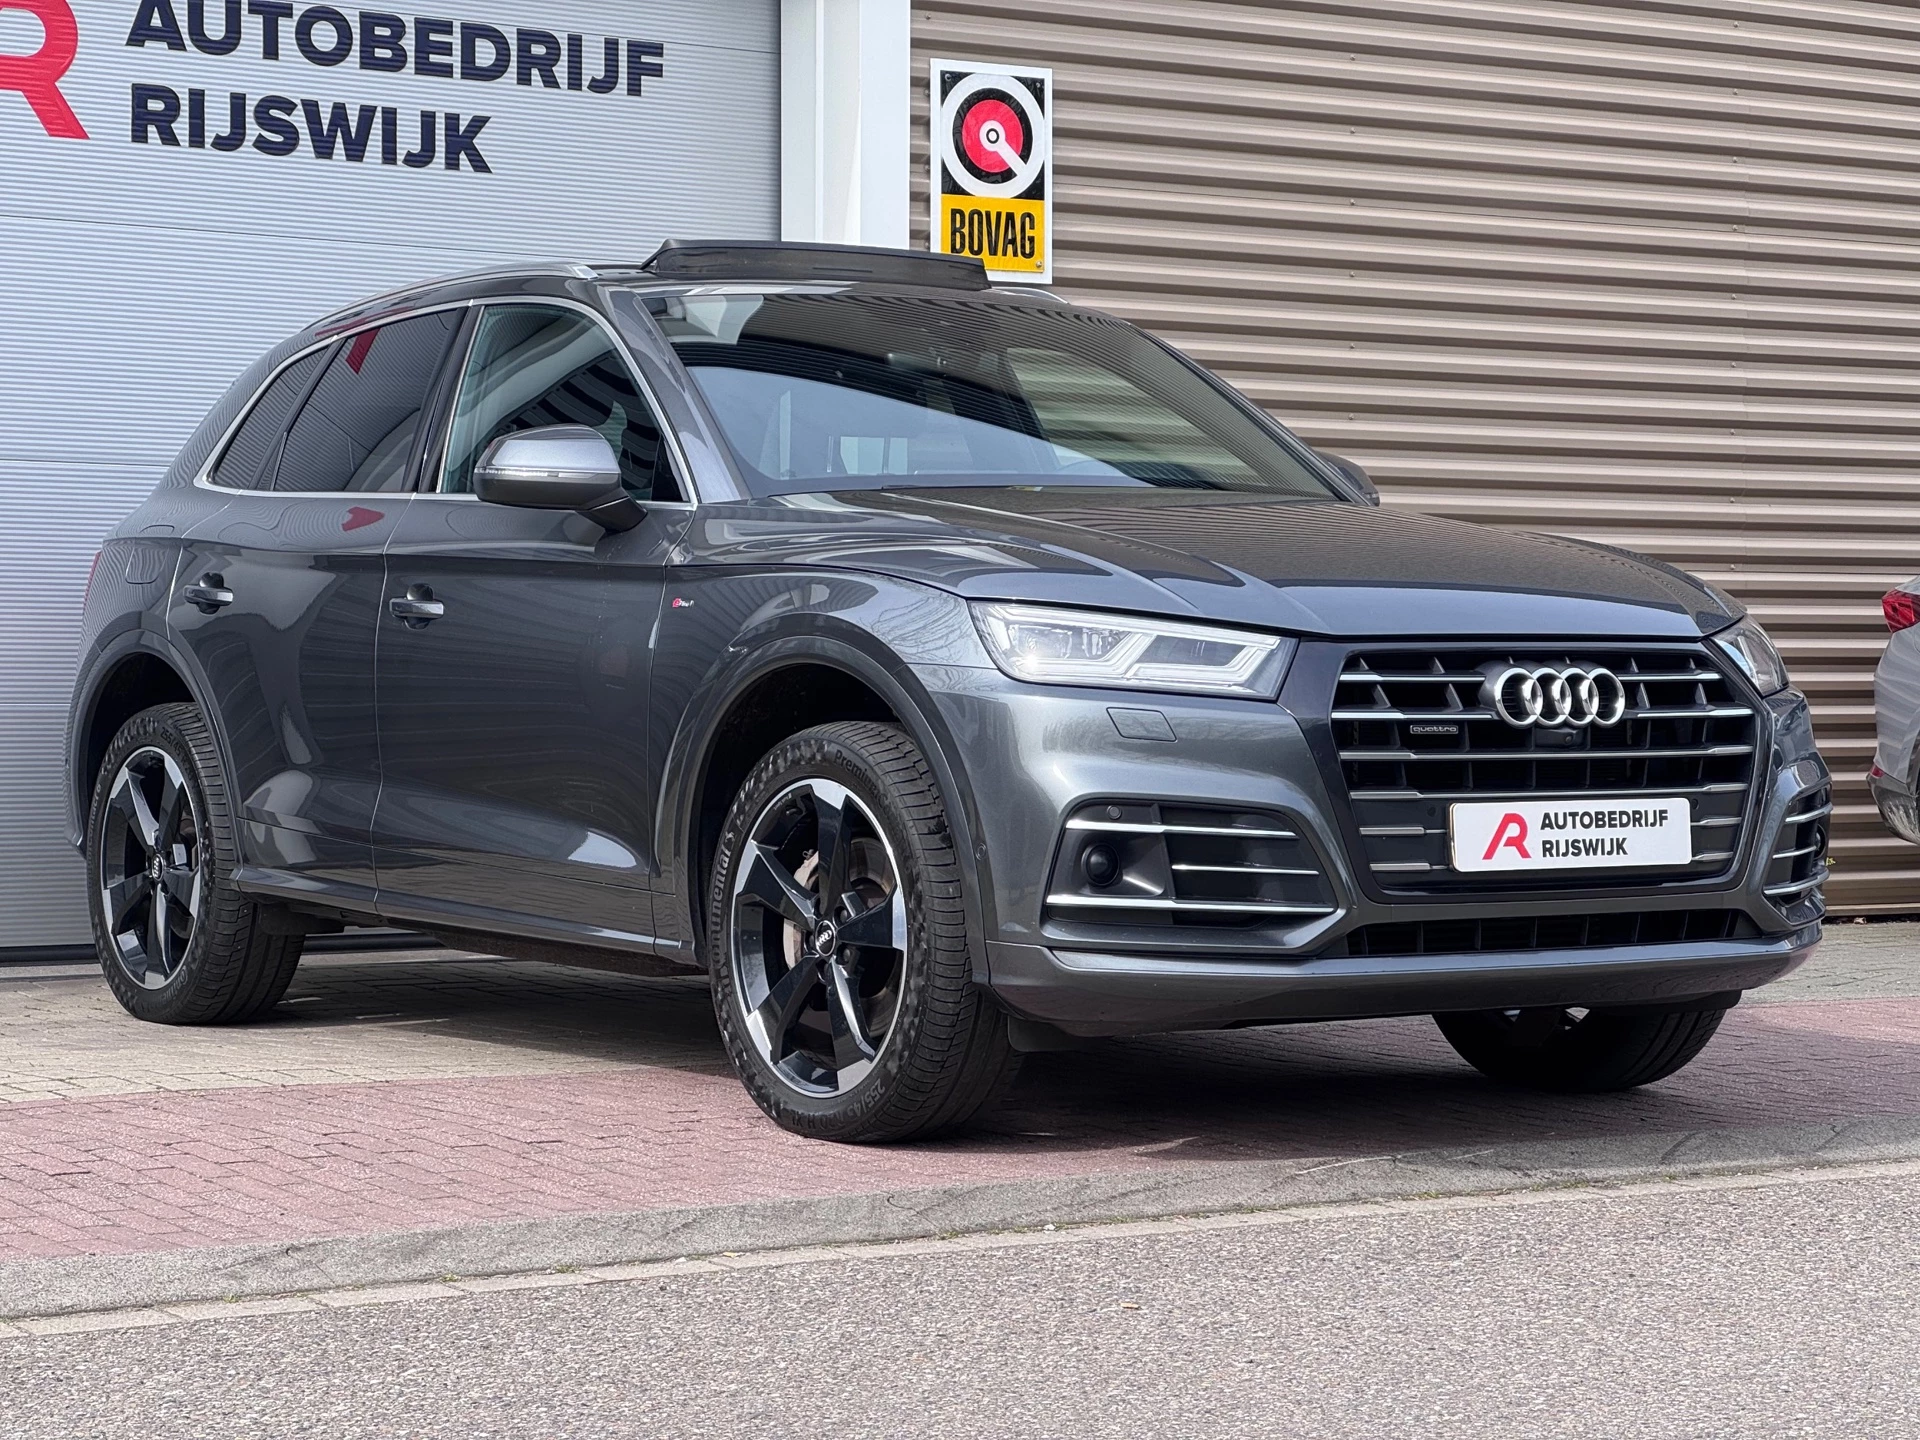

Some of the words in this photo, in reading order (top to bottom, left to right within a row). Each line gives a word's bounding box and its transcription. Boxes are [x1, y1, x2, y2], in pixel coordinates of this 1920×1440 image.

[125, 0, 664, 97] AUTOBEDRIJF
[130, 83, 493, 174] RIJSWIJK
[950, 208, 1036, 259] BOVAG
[1540, 809, 1669, 830] AUTOBEDRIJF
[1542, 837, 1628, 858] RIJSWIJK
